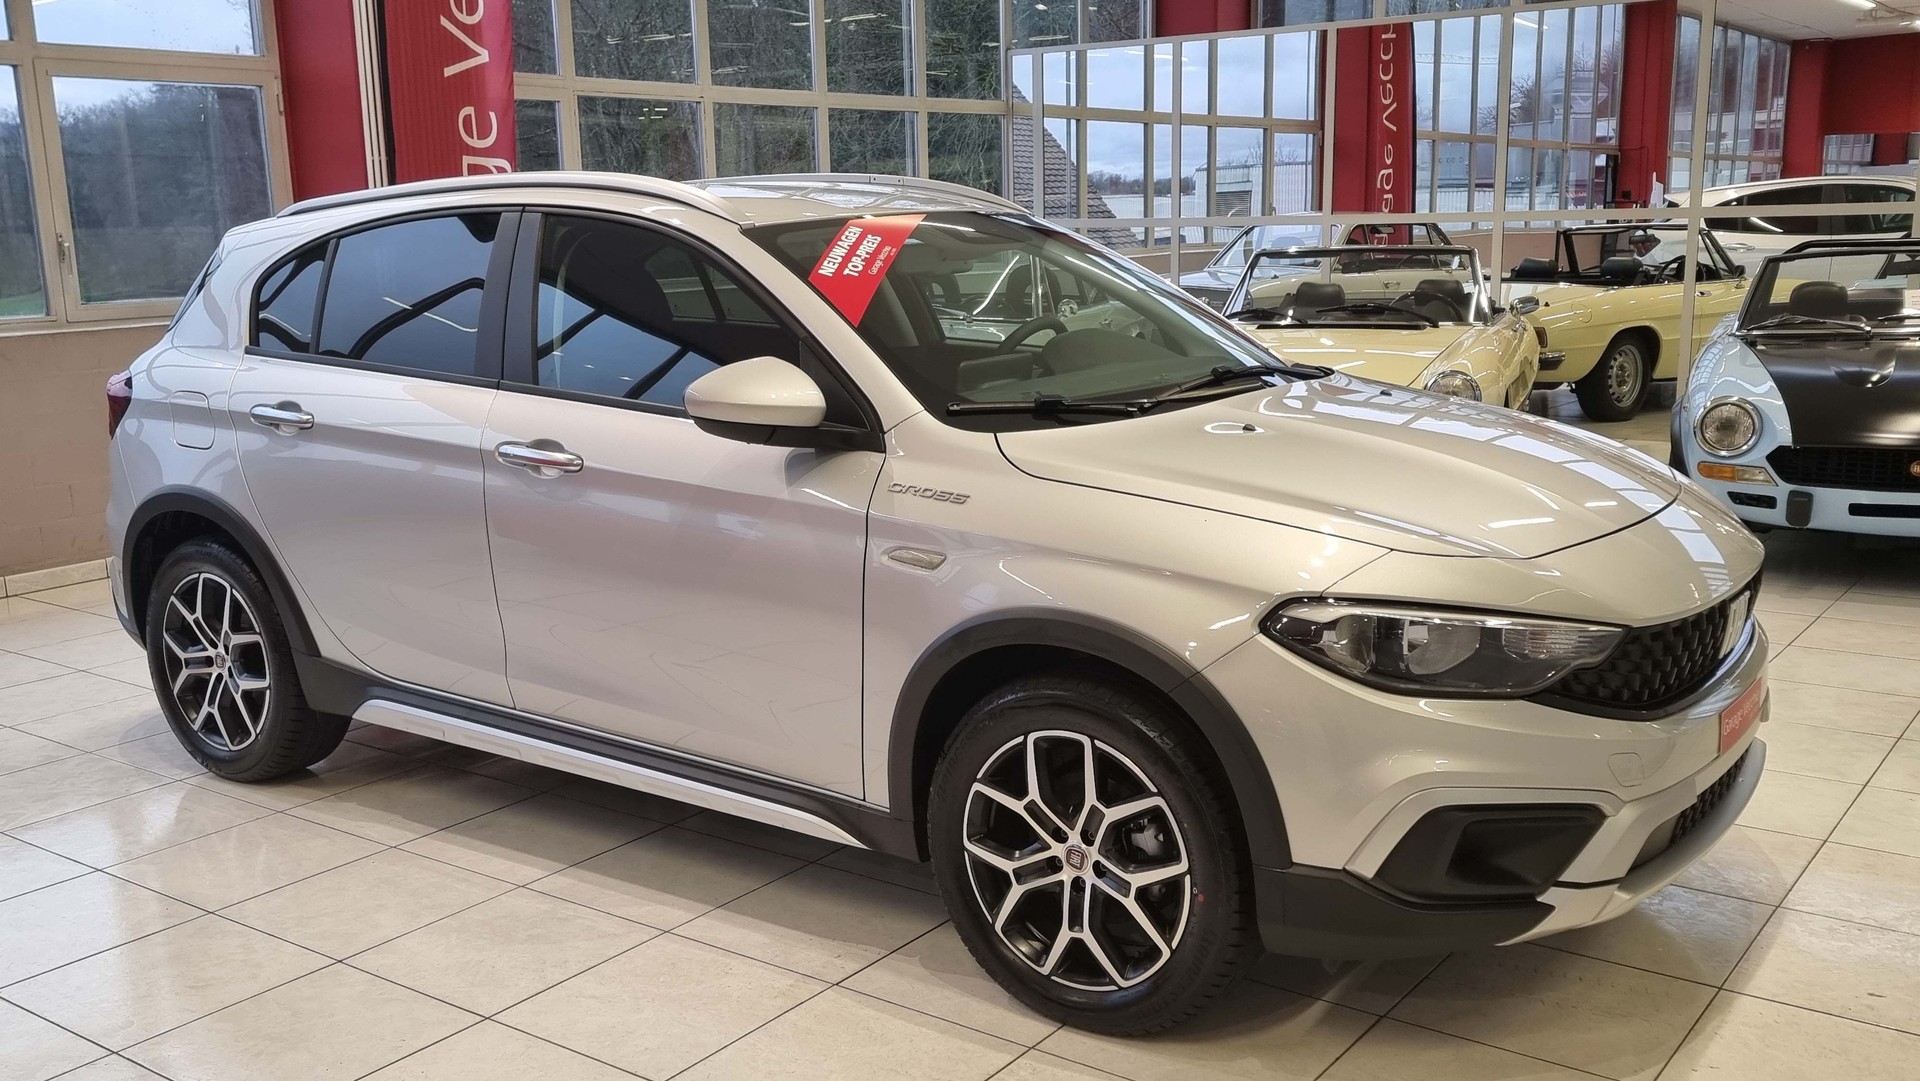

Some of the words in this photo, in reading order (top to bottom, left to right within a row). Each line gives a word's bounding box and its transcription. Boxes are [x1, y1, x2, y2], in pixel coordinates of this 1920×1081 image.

[818, 225, 863, 277] NEUWAGEN
[843, 234, 882, 277] TOP-PREIS
[887, 481, 971, 505] CROSS
